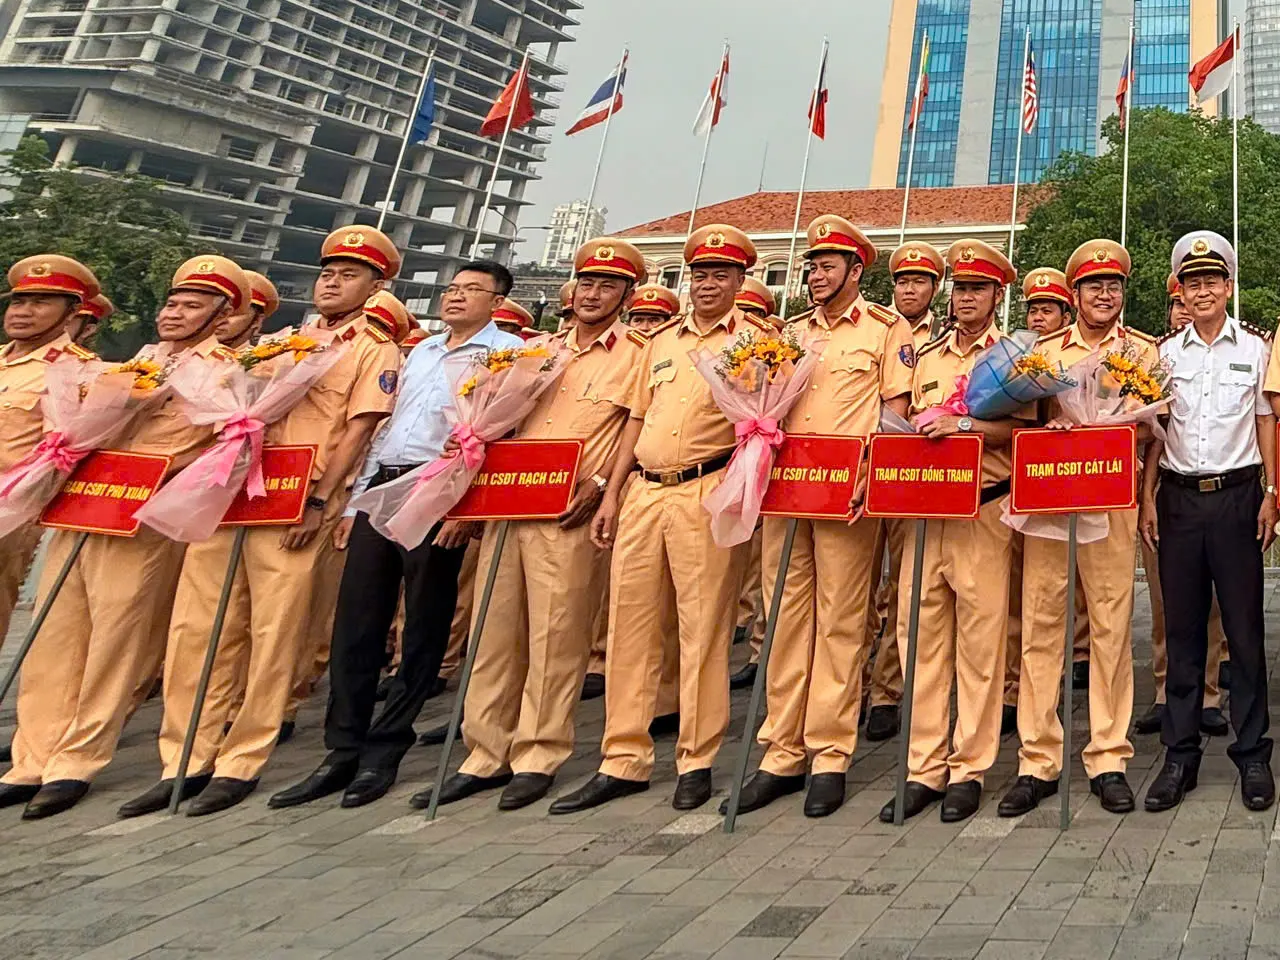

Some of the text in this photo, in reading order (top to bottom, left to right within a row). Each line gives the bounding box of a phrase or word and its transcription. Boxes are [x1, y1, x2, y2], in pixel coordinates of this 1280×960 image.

[782, 467, 808, 481] CSĐT
[829, 467, 850, 483] KHÔ
[875, 468, 897, 484] TRẠM
[899, 468, 920, 481] CSĐT
[946, 468, 973, 482] TRANH
[1025, 457, 1123, 479] TRẠM CSĐT CÁT LÁI
[281, 475, 301, 490] SÁT
[490, 472, 517, 486] CSĐT
[518, 472, 547, 487] RẠCH
[548, 469, 569, 484] CÁT
